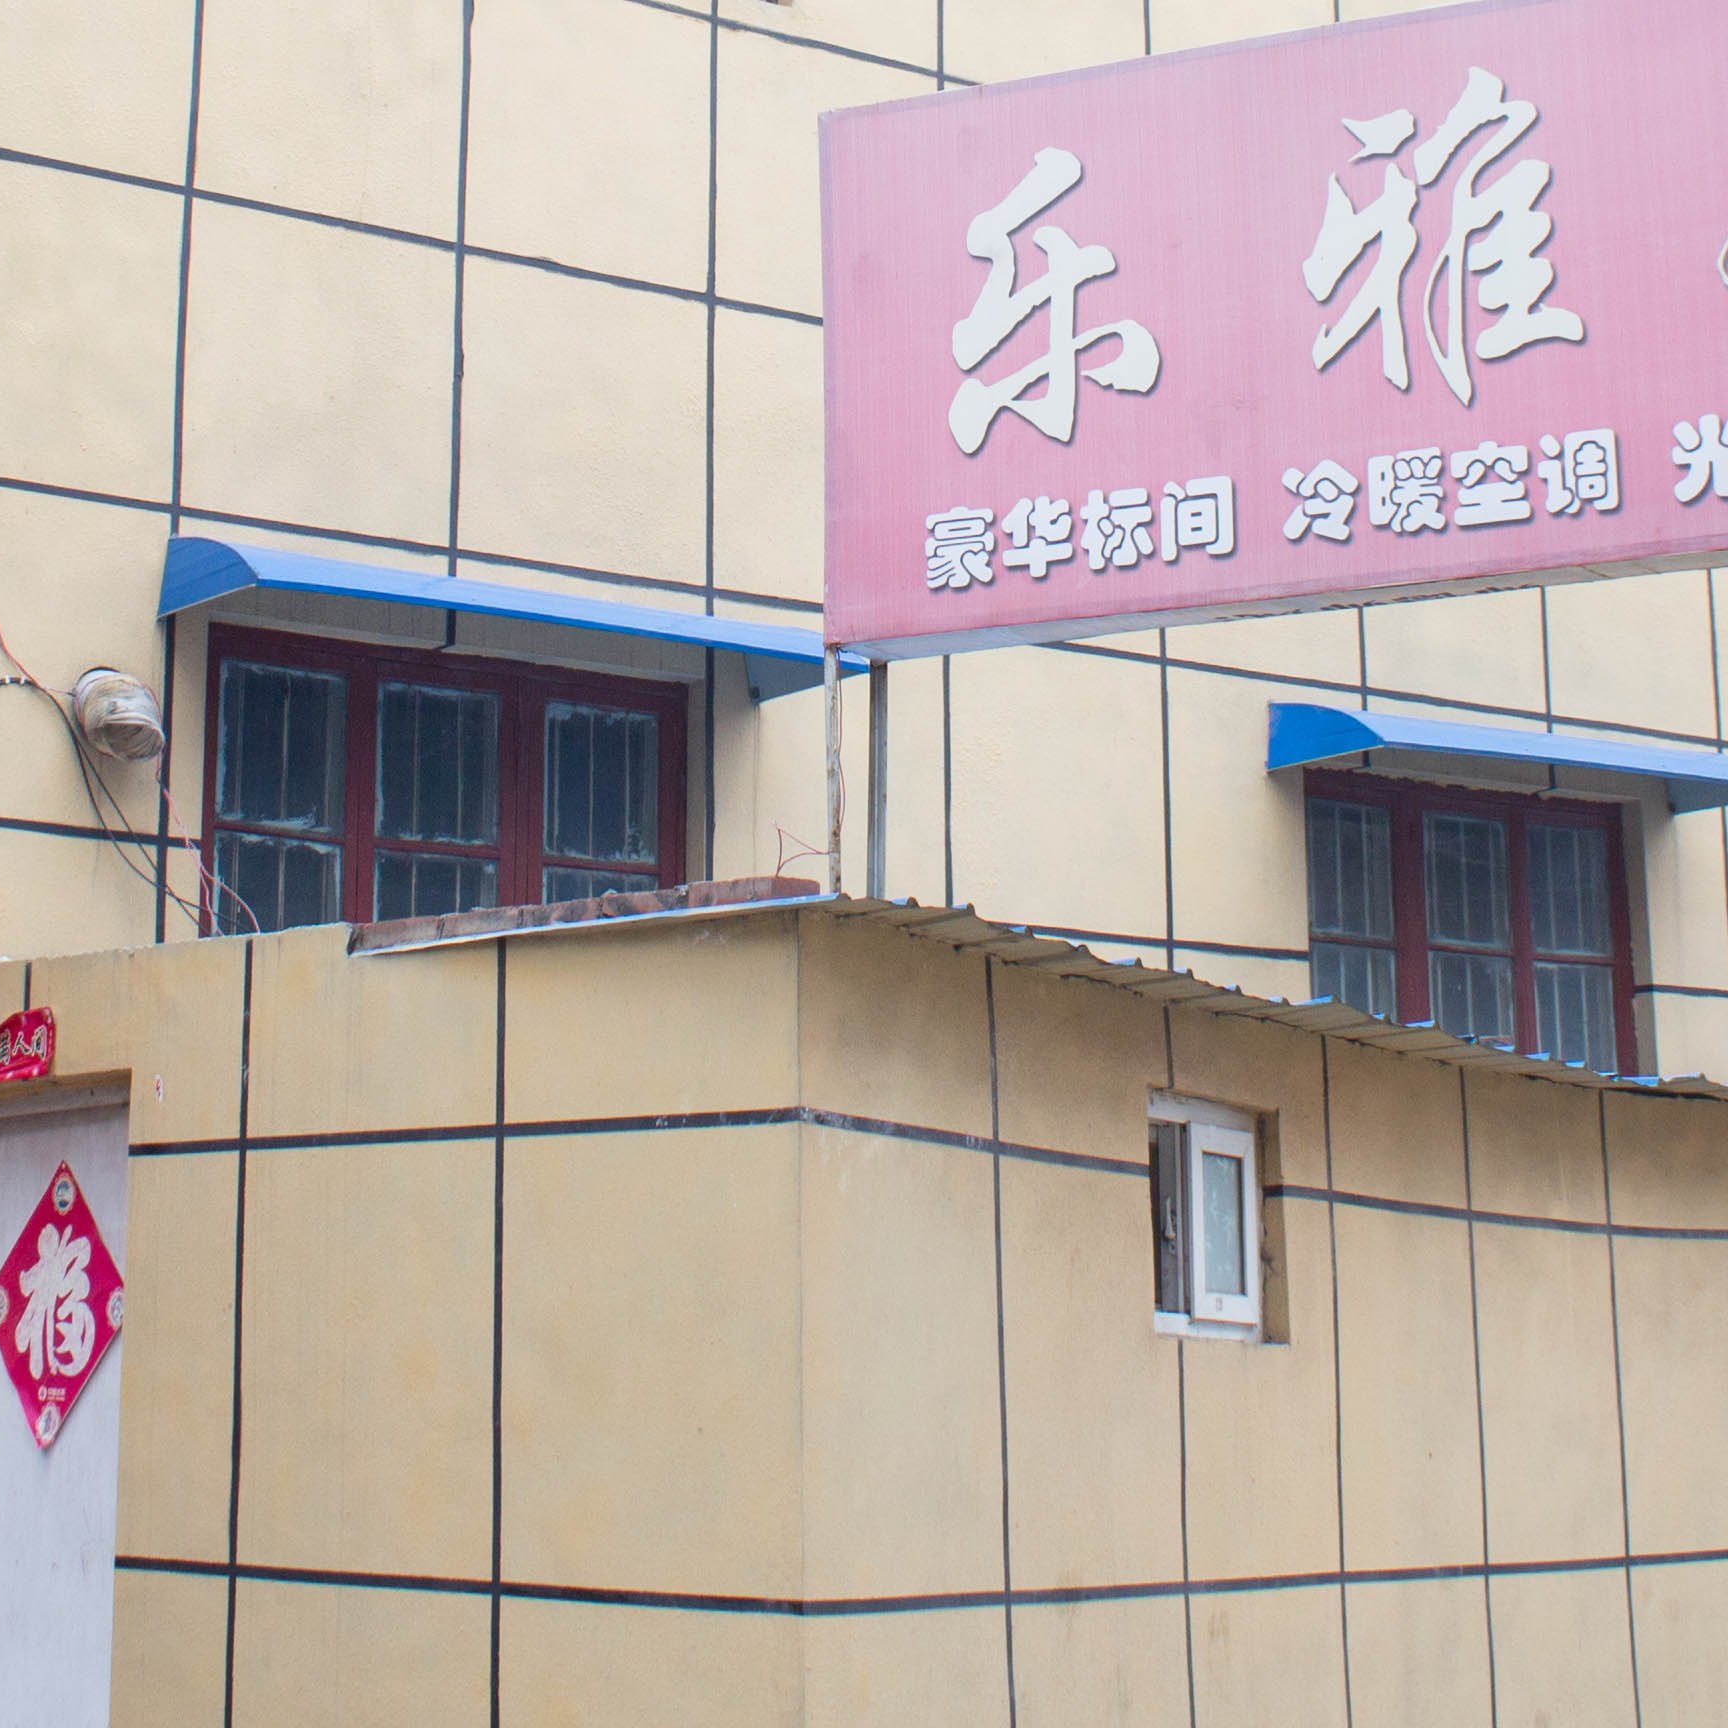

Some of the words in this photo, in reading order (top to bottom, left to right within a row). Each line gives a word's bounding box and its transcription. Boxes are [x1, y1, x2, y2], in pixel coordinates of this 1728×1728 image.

[924, 476, 1236, 589] 豪华标间
[1281, 428, 1621, 541] 冷暖空调
[15, 1223, 96, 1380] 福
